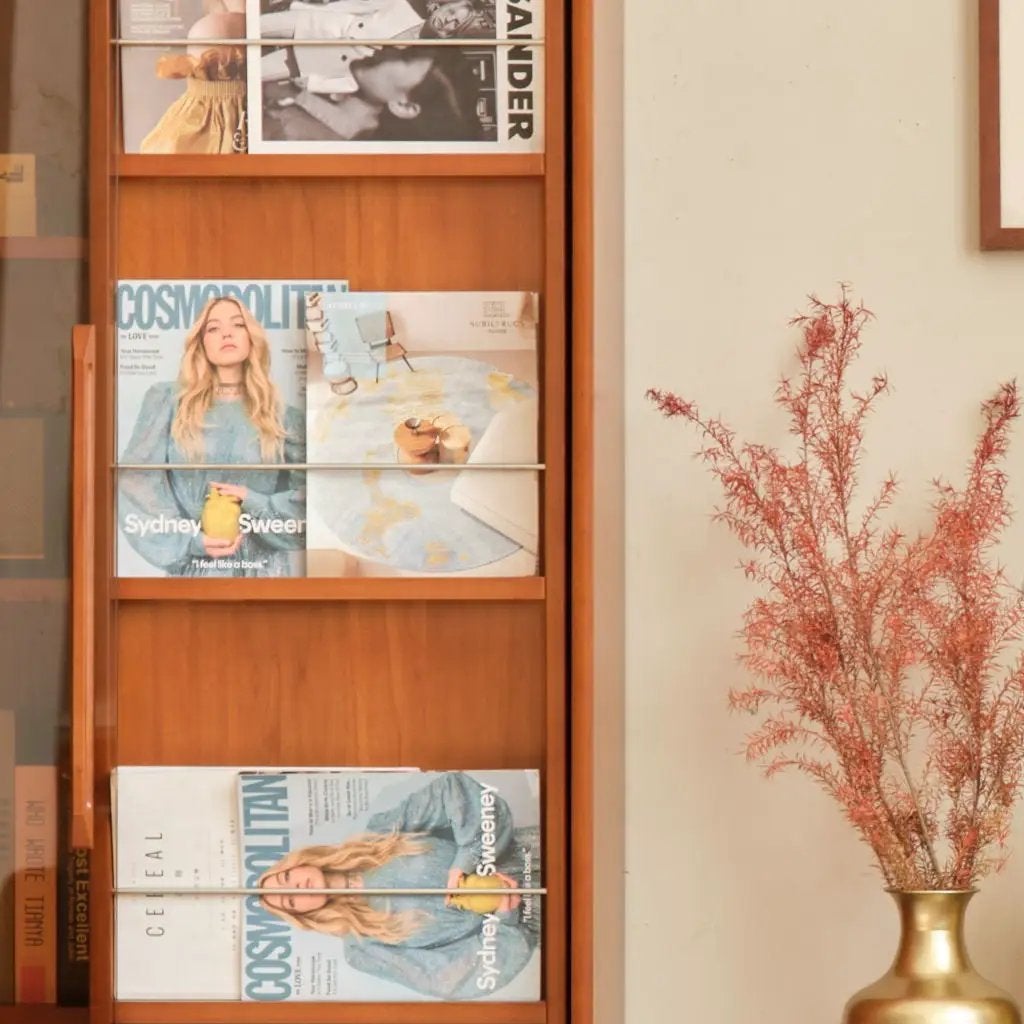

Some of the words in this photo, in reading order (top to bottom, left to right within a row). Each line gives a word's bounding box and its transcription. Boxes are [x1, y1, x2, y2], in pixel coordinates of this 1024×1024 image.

[507, 0, 534, 140] ANDER
[117, 283, 347, 330] COSMOLIT
[124, 514, 201, 537] Sydney
[200, 559, 217, 569] feel
[217, 559, 233, 569] like
[233, 561, 240, 569] a
[76, 848, 89, 875] ost
[476, 783, 499, 877] Sweeney
[76, 881, 89, 961] Excellent
[242, 775, 292, 1001] COSMOLITAN
[477, 913, 500, 991] Sydney
